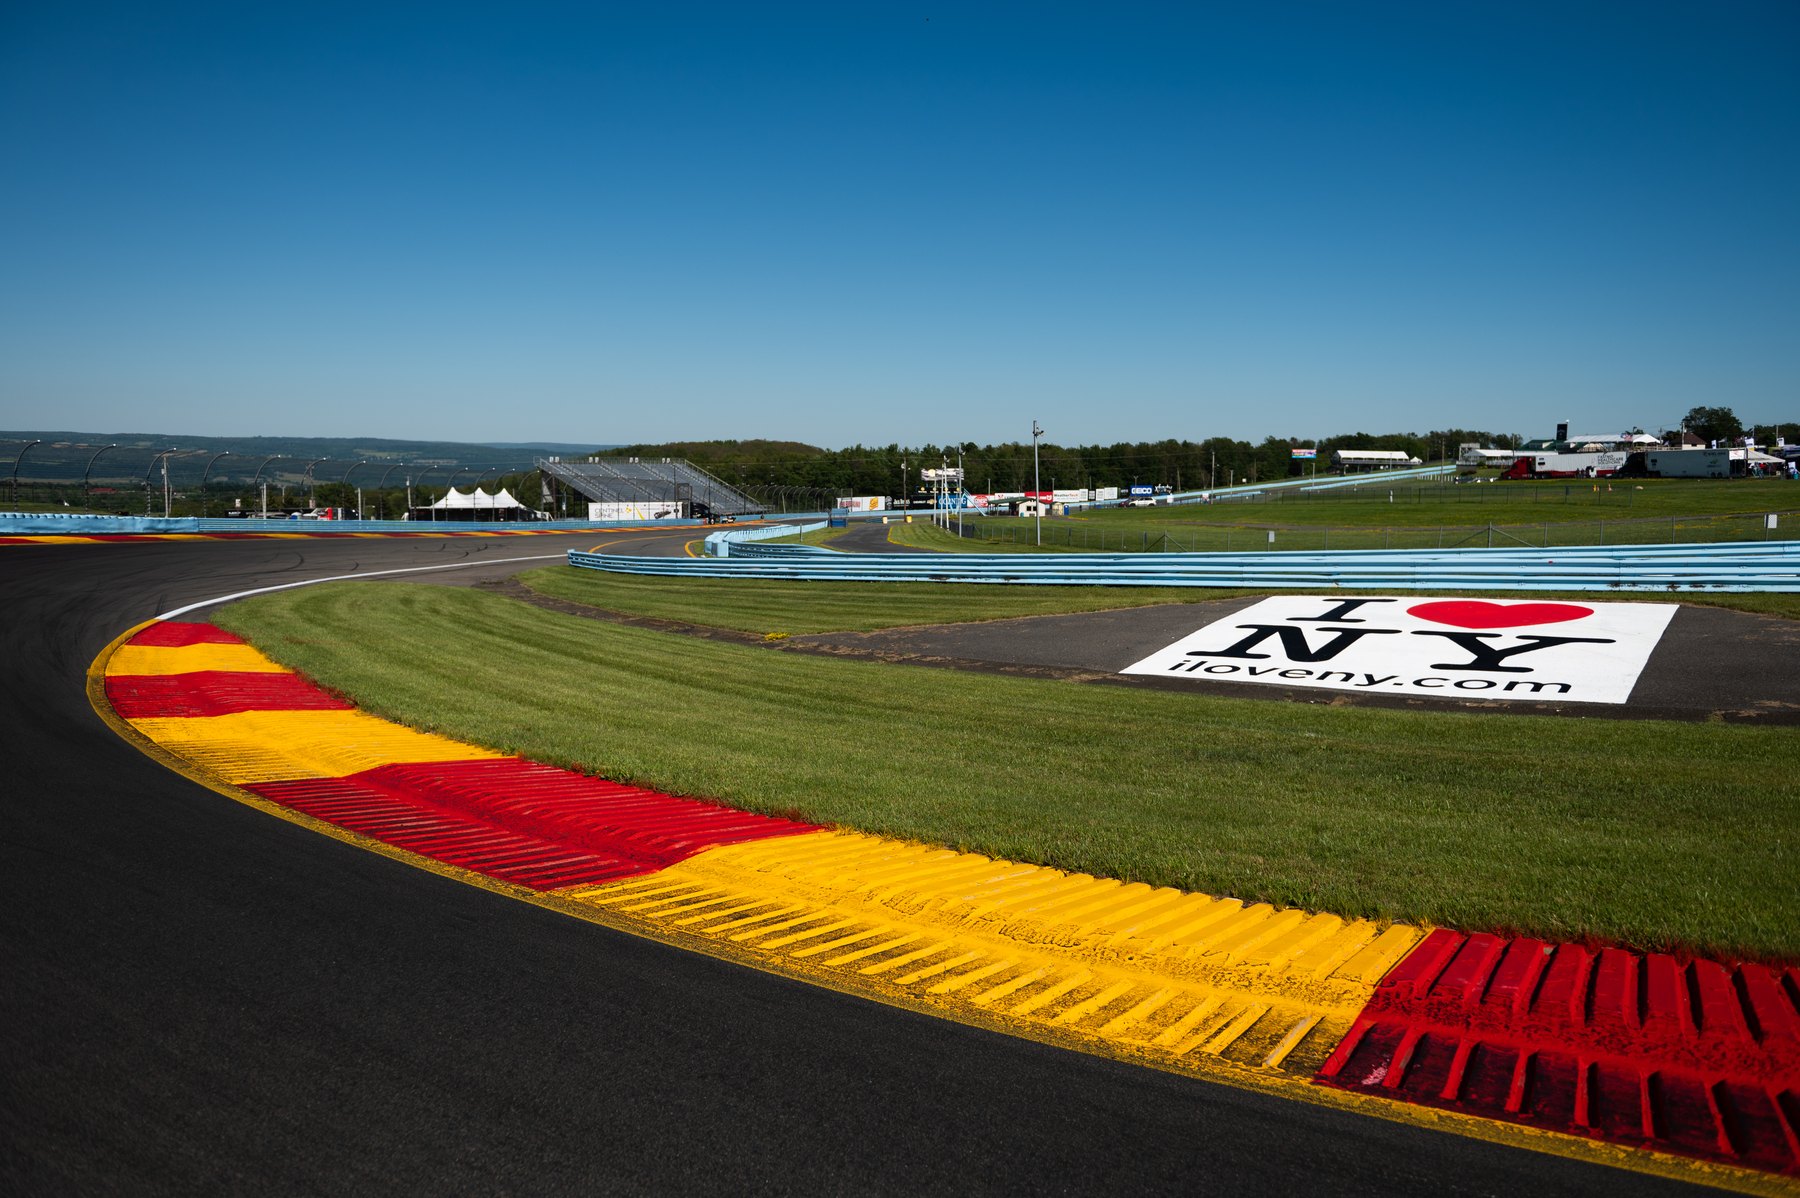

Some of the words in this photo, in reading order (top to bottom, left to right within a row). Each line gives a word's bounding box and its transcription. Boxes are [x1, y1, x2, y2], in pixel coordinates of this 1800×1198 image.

[938, 497, 967, 505] CONG
[1131, 487, 1153, 495] GEICO
[1286, 598, 1398, 622] I
[1186, 624, 1617, 673] NY
[1168, 659, 1572, 694] iloveny.com
